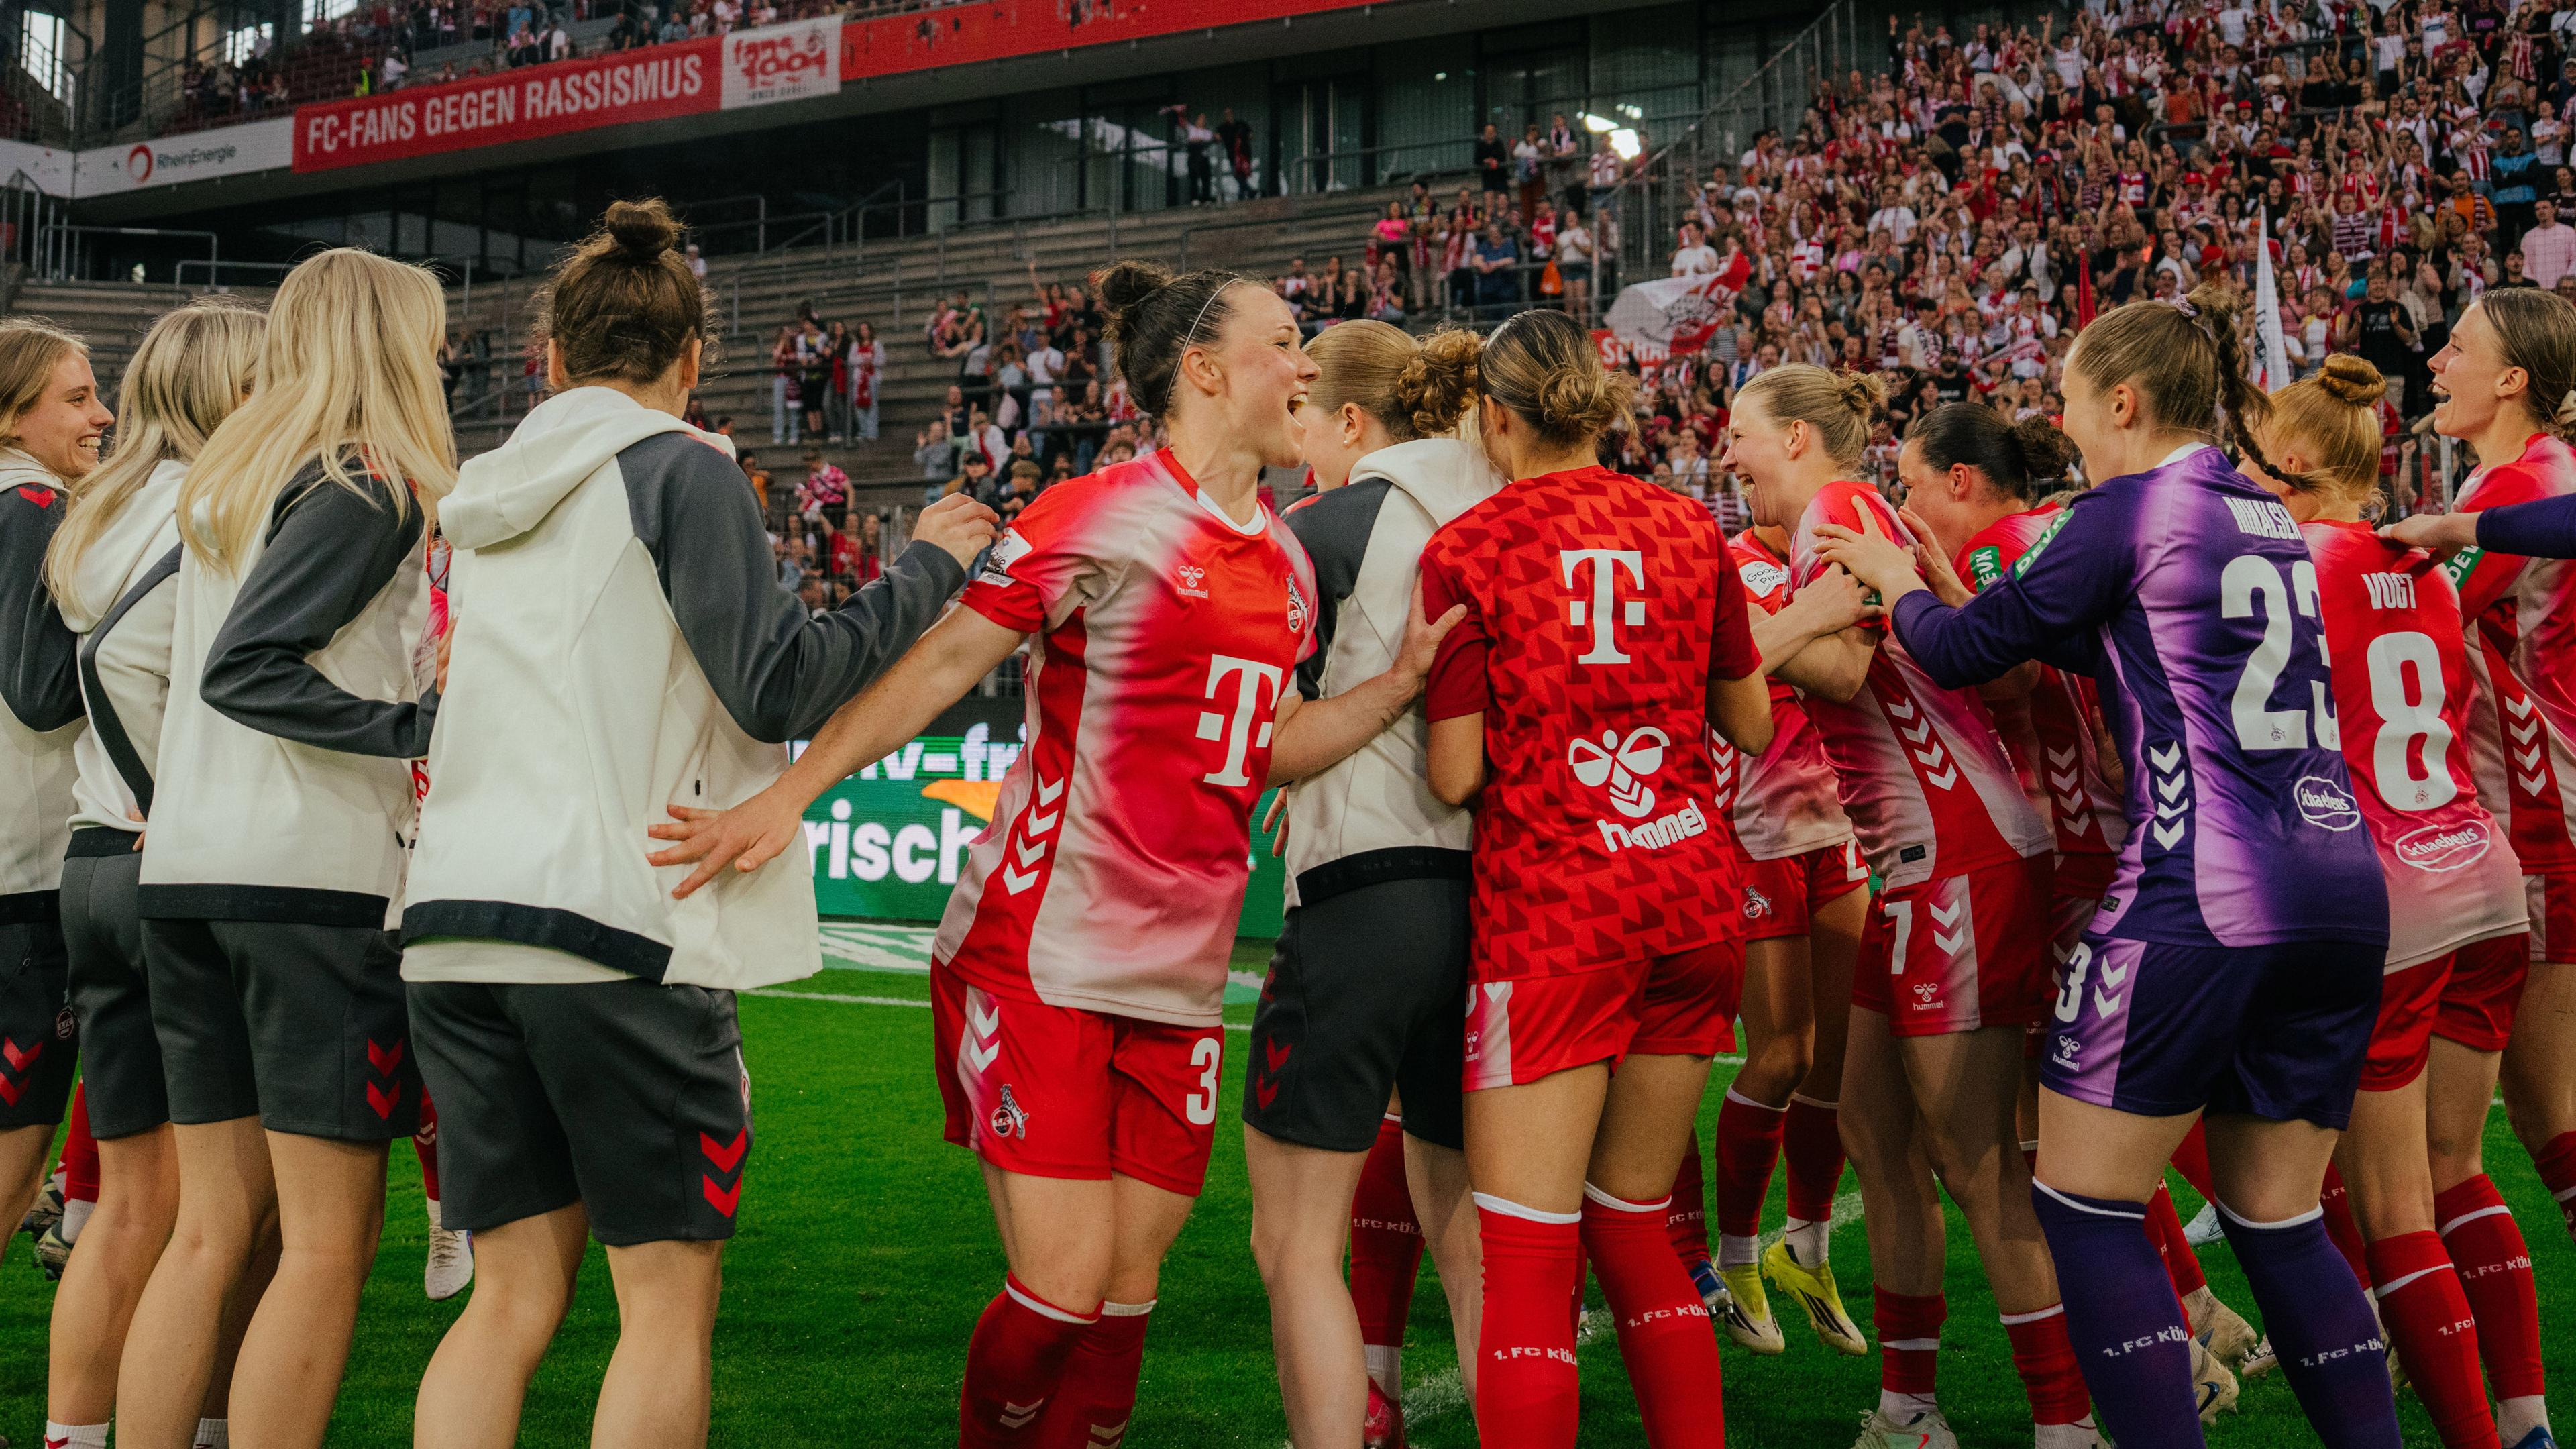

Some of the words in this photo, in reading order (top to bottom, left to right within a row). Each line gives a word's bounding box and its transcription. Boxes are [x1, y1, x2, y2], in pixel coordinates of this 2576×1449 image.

[309, 101, 415, 154] FC-FANS
[425, 88, 515, 136] GEGEN
[526, 55, 702, 119] RASSISMUS
[157, 143, 237, 168] RheinEnergie
[1976, 549, 1998, 586] EVK
[2448, 545, 2480, 584] DEV
[1177, 585, 1209, 598] hummel
[1560, 549, 1646, 664] T
[2361, 572, 2417, 610] VOGT
[2221, 555, 2341, 751] 23
[1195, 654, 1283, 787] T
[2367, 631, 2459, 812] 8
[804, 798, 981, 885] risch
[1884, 900, 1912, 974] 7
[2055, 942, 2092, 1022] 3
[1913, 1000, 1943, 1010] hummel
[2053, 1052, 2080, 1072] hummel
[1186, 1038, 1220, 1125] 3
[1362, 1218, 1382, 1228] FC
[2477, 1264, 2503, 1277] FC
[2506, 1256, 2532, 1270] KÖL
[1643, 1311, 1672, 1322] FC
[1675, 1303, 1710, 1317] KÖL
[2438, 1326, 2453, 1336] 1.
[2455, 1319, 2471, 1332] FC
[1494, 1350, 1508, 1360] 1.
[1511, 1347, 1541, 1358] FC
[1547, 1348, 1578, 1366] KÖL
[2103, 1347, 2121, 1356] 1.
[2123, 1336, 2153, 1353] FC
[2157, 1326, 2188, 1342] KÖL
[2318, 1348, 2349, 1364] FC
